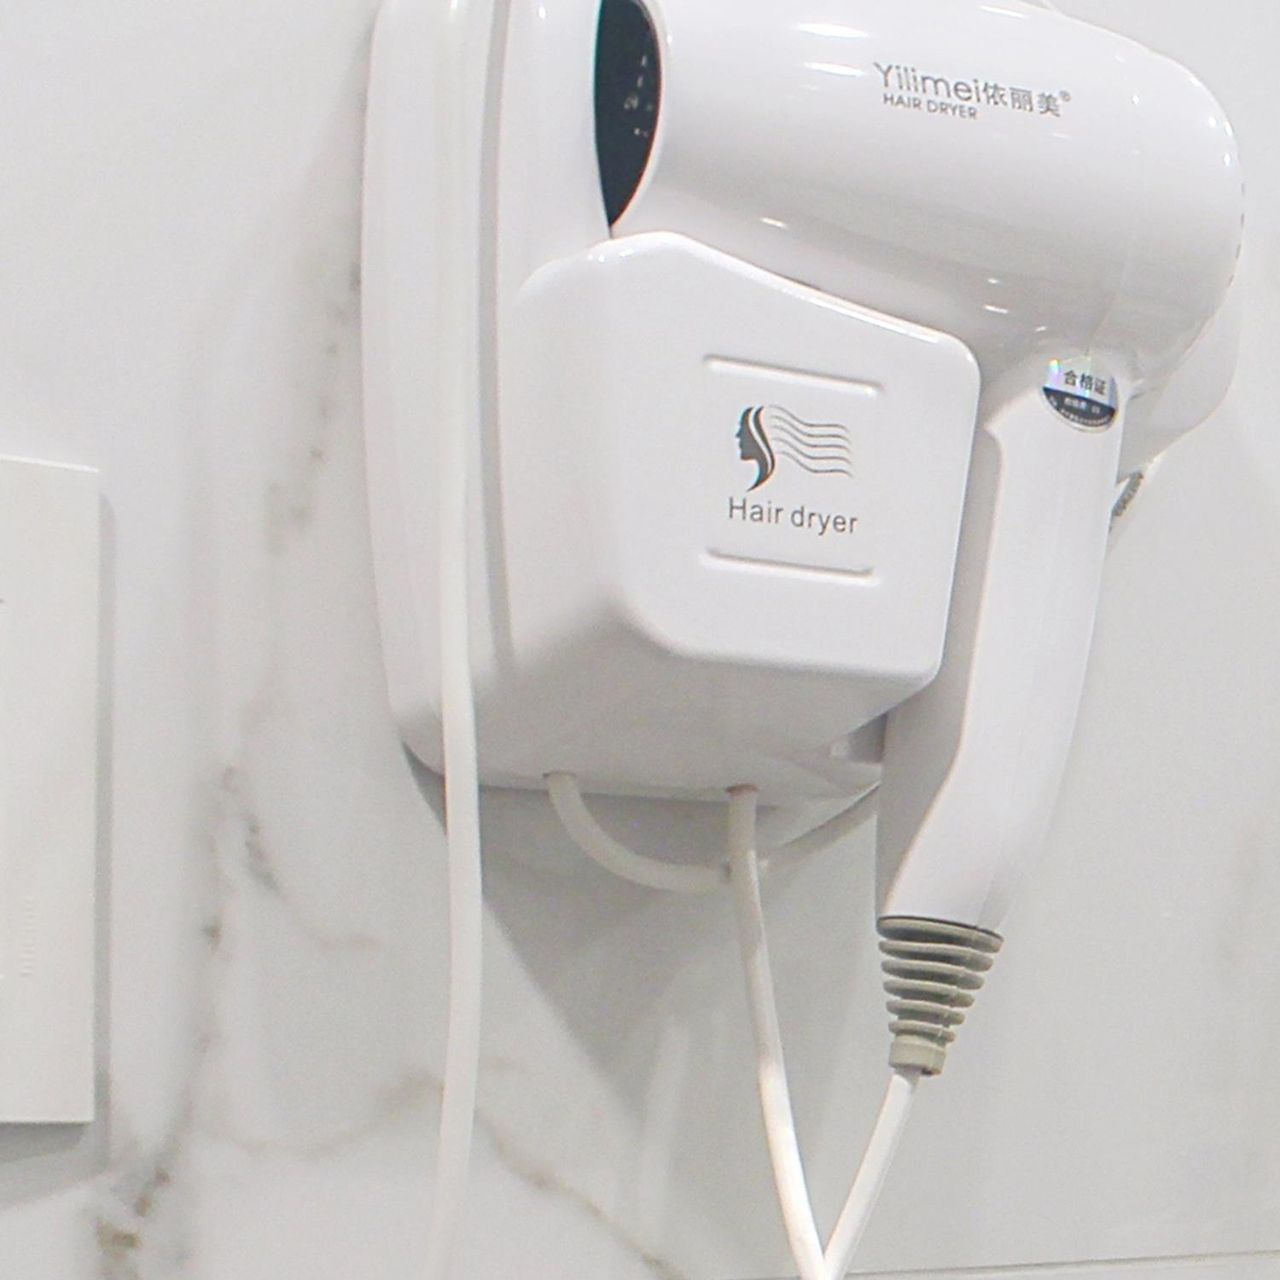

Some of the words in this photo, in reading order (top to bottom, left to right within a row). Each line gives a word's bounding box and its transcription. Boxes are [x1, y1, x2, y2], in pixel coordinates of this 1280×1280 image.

[883, 93, 922, 110] HAIR
[926, 99, 979, 120] DRYER
[728, 496, 784, 524] Hair
[790, 505, 858, 536] dryer
